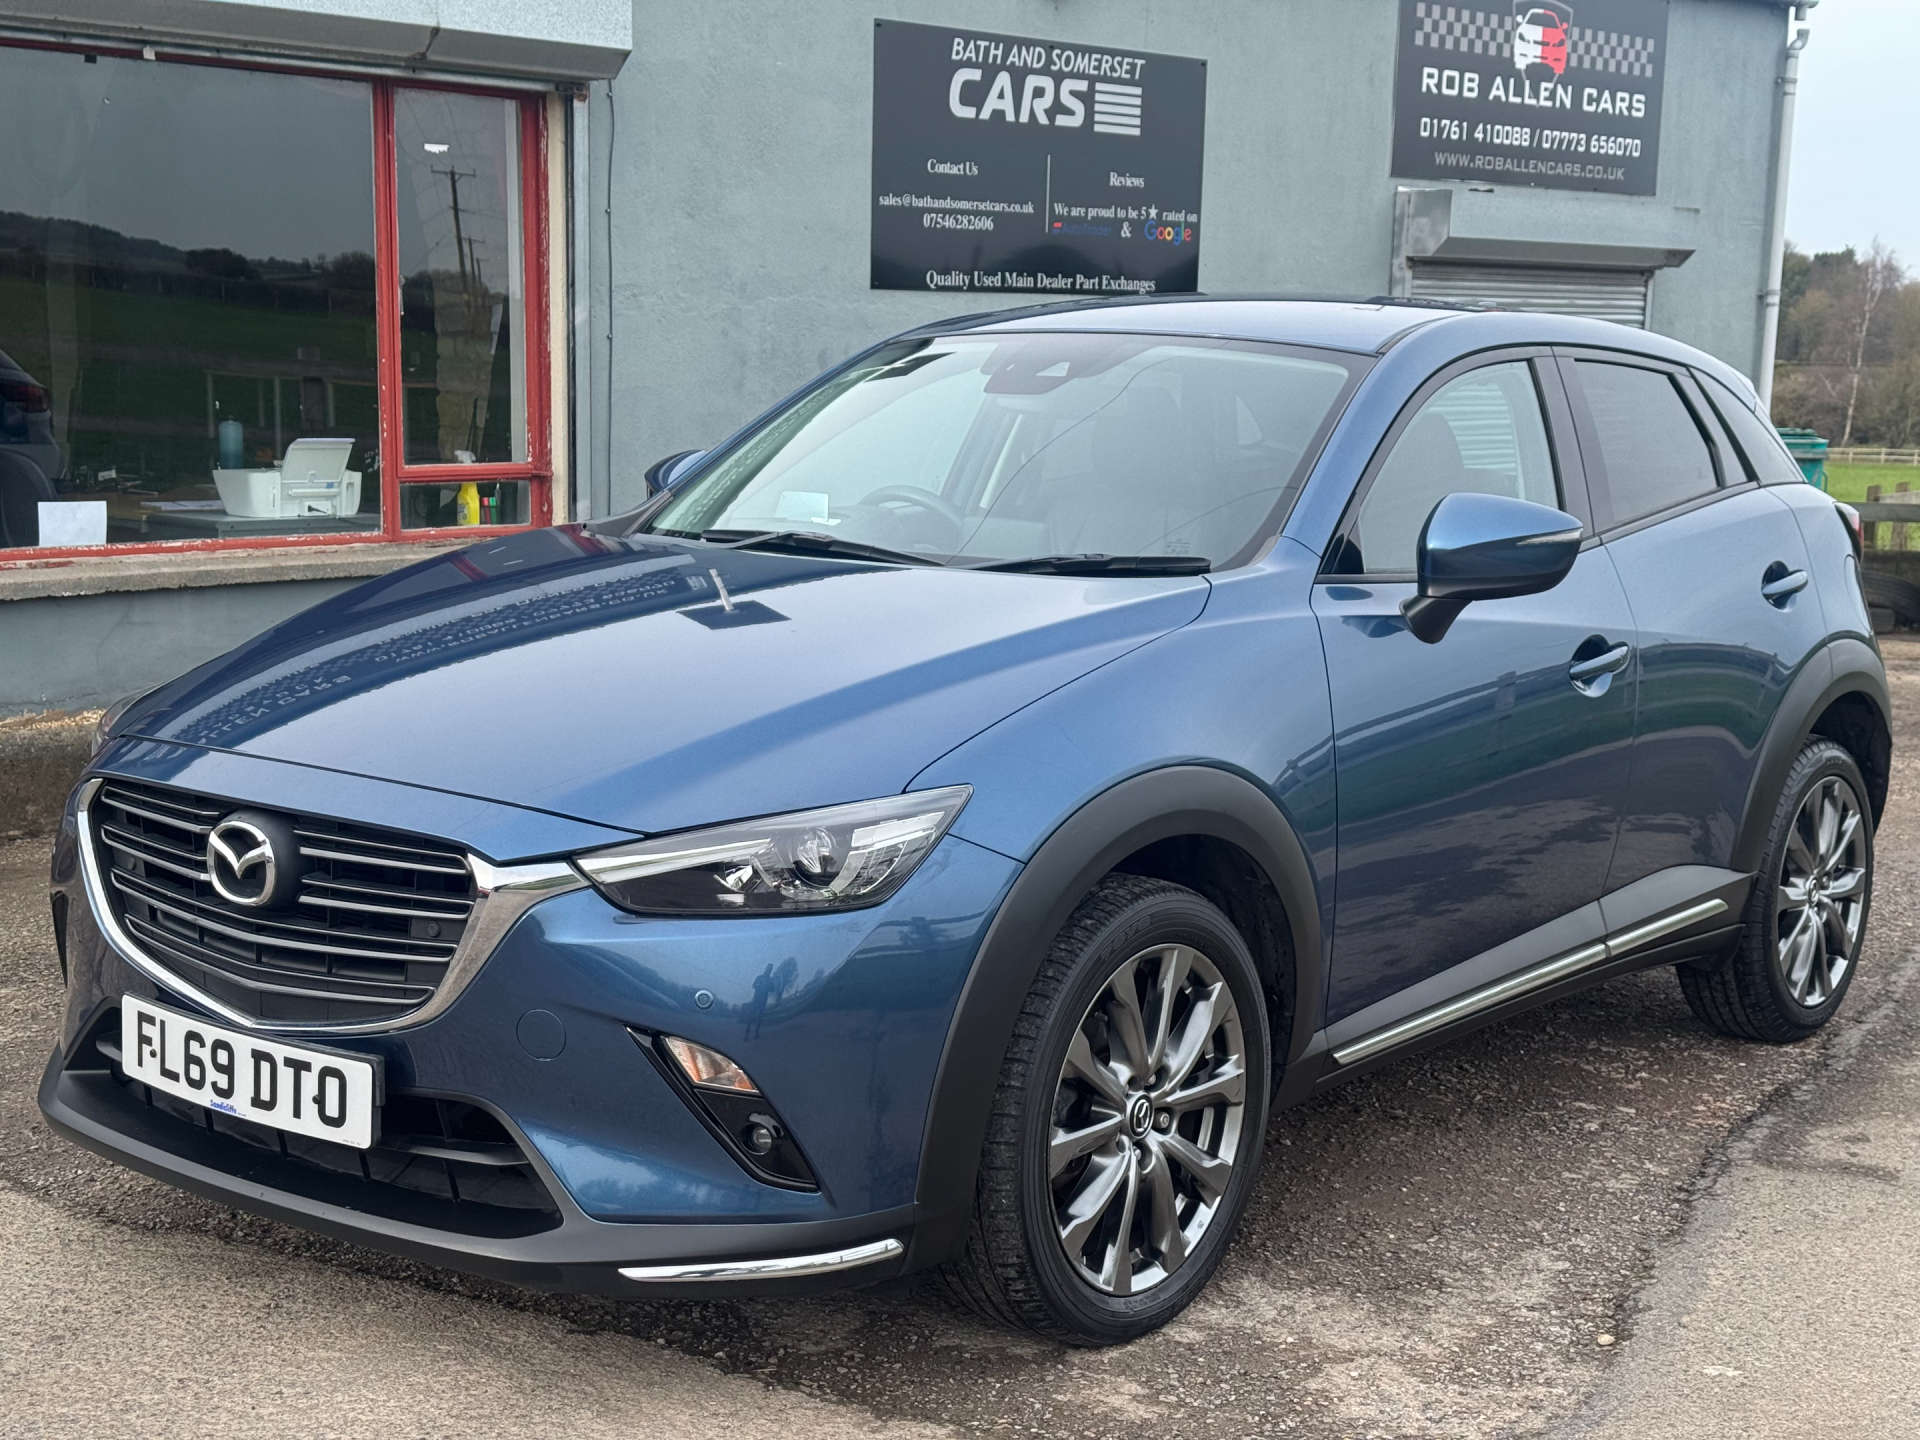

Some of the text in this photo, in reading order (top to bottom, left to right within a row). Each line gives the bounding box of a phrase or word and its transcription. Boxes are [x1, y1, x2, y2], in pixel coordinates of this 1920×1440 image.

[951, 37, 1146, 80] BATH AND SOMERSET
[949, 67, 1089, 127] CARS
[1421, 66, 1646, 118] ROB ALLEN CARS
[1419, 117, 1468, 139] 01761
[1474, 122, 1531, 146] 410088
[1541, 129, 1586, 152] 07773
[1590, 134, 1642, 157] 656070
[927, 158, 979, 176] Contact Us
[1434, 151, 1625, 181] WWW.ROBALLENCARS.CO.UK
[1109, 171, 1145, 188] Reviews
[879, 193, 1035, 213] sales@bathandsomersetcars.co.uk
[1054, 203, 1069, 216] We
[1070, 206, 1086, 216] are
[1087, 205, 1115, 220] proud
[1117, 207, 1127, 219] to
[1128, 206, 1139, 219] be
[1162, 209, 1185, 222] rated
[1186, 213, 1198, 223] on
[923, 213, 994, 231] 07546282606
[1120, 221, 1132, 238] &
[1144, 220, 1192, 246] Google
[925, 270, 1156, 295] Quality Used Main Dealer Part Exchanges
[137, 1010, 347, 1128] FL69 DTO
